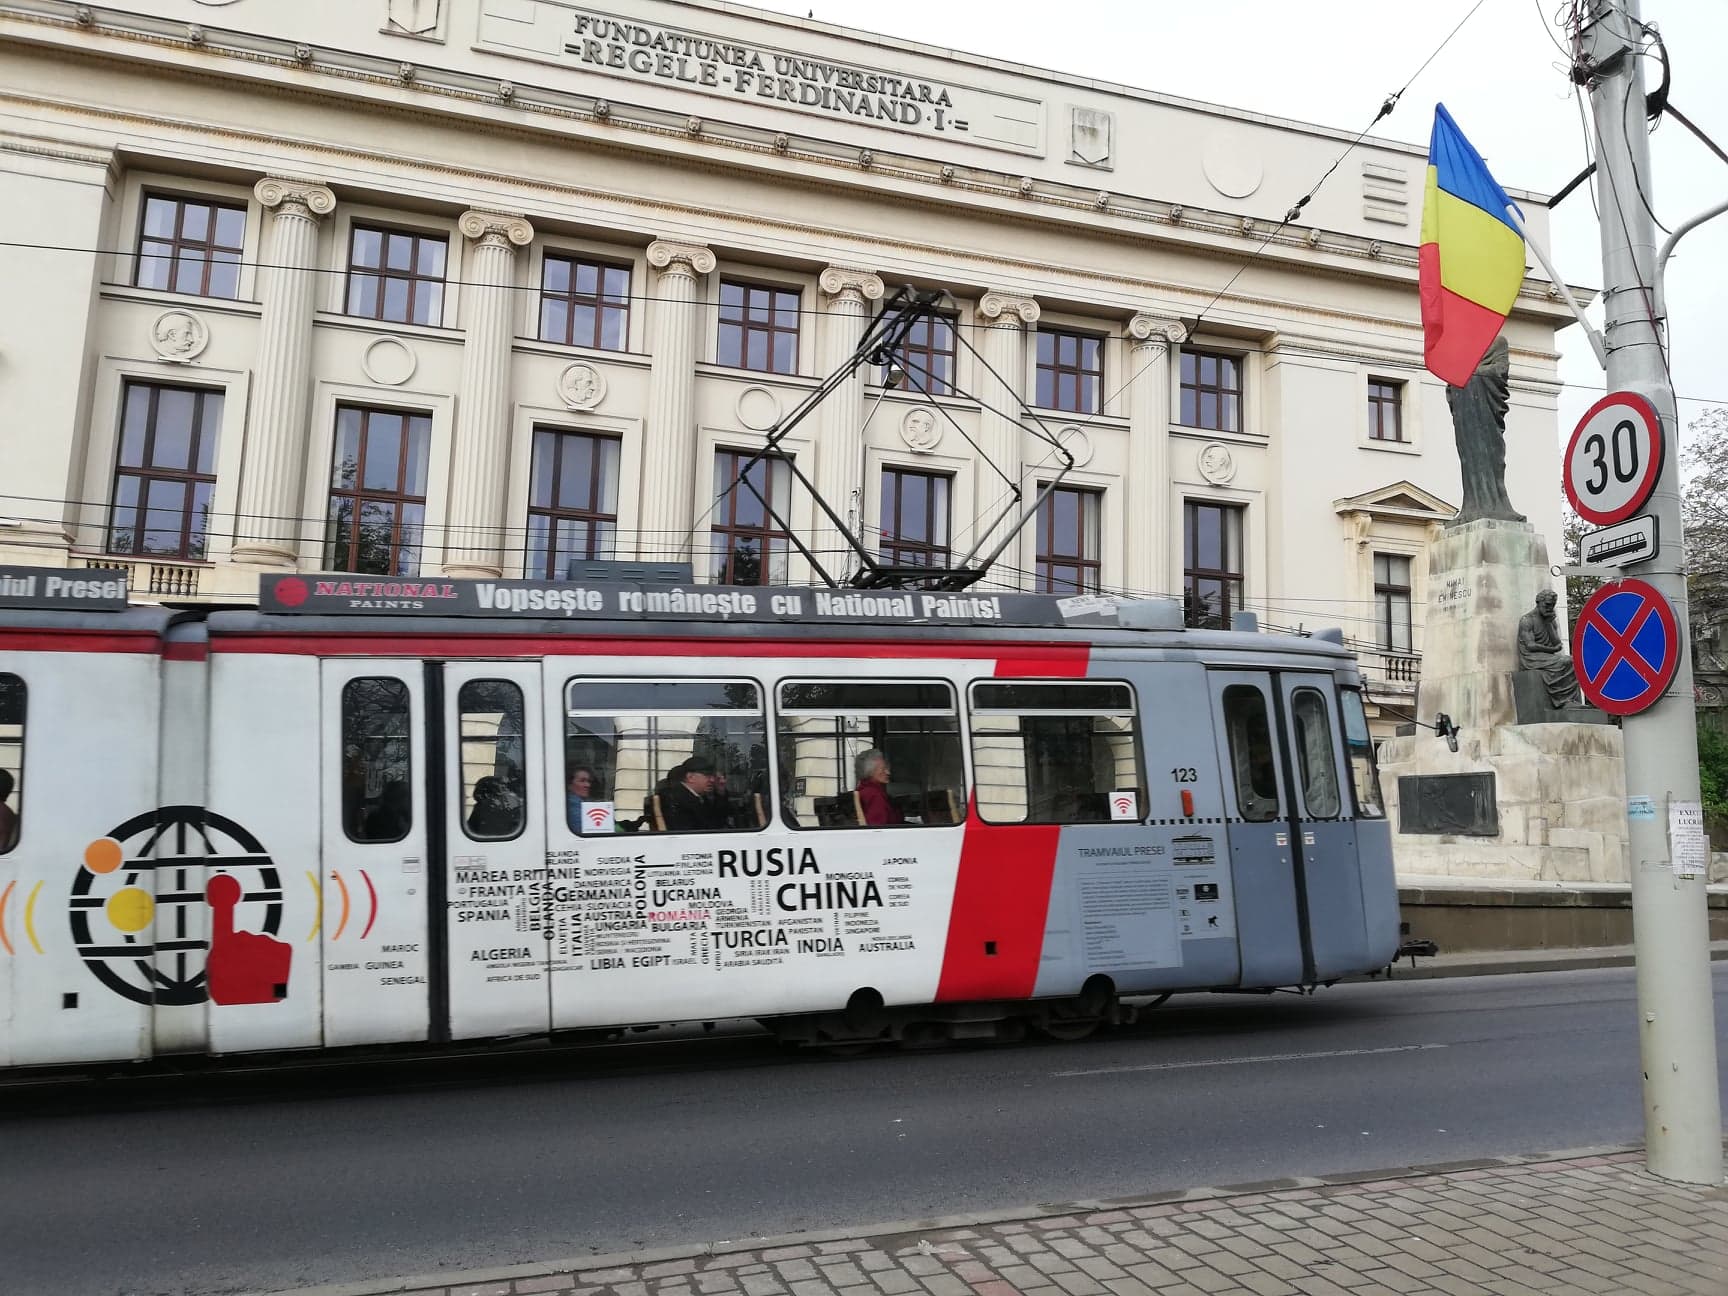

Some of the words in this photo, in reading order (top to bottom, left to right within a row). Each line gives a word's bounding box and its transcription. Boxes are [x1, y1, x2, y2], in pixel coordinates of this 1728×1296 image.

[574, 14, 765, 72] FUNDATIUNEA
[773, 55, 952, 107] UNIVERSITARA
[1584, 419, 1639, 495] 30
[45, 576, 126, 599] Presei
[314, 581, 459, 599] NATIONAL
[349, 600, 424, 609] PAINTS
[475, 583, 603, 616] Vopsește
[770, 595, 802, 615] cu
[815, 592, 915, 617] National
[921, 595, 1002, 619] Paints!
[1171, 768, 1198, 782] 123
[597, 856, 631, 865] SUEDIA
[718, 847, 821, 879] RUSIA
[882, 857, 918, 866] JAPONIA
[455, 870, 509, 884] MAREA
[513, 867, 581, 882] BRITANIE
[584, 867, 631, 876] NORVEGIA
[825, 871, 874, 881] MONGOLIA
[574, 879, 631, 888] DANEMARCA
[634, 854, 647, 919] POLONIA
[655, 878, 696, 887] BELARUS
[555, 886, 632, 902] GERMANIA
[652, 887, 722, 908] UCRAINA
[776, 880, 884, 912] CHINA
[529, 882, 541, 931] BELGIA
[542, 882, 554, 940] OLANDA
[586, 901, 632, 911] SLOVACIA
[688, 900, 735, 909] MOLDOVA
[457, 909, 511, 923] SPANIA
[584, 910, 633, 922] AUSTRIA
[595, 919, 647, 931] UNGARIA
[652, 920, 708, 932] BULGARIA
[571, 913, 582, 957] ITALIA
[711, 928, 788, 949] TURCIA
[382, 943, 420, 952] MAROC
[797, 937, 844, 954] INDIA
[858, 940, 916, 953] AUSTRALIA
[471, 947, 532, 961] ALGERIA
[365, 961, 404, 970] GUINEA
[590, 957, 626, 970] LIBIA
[632, 955, 671, 968] EGIPT
[380, 976, 427, 986] SENEGAL
